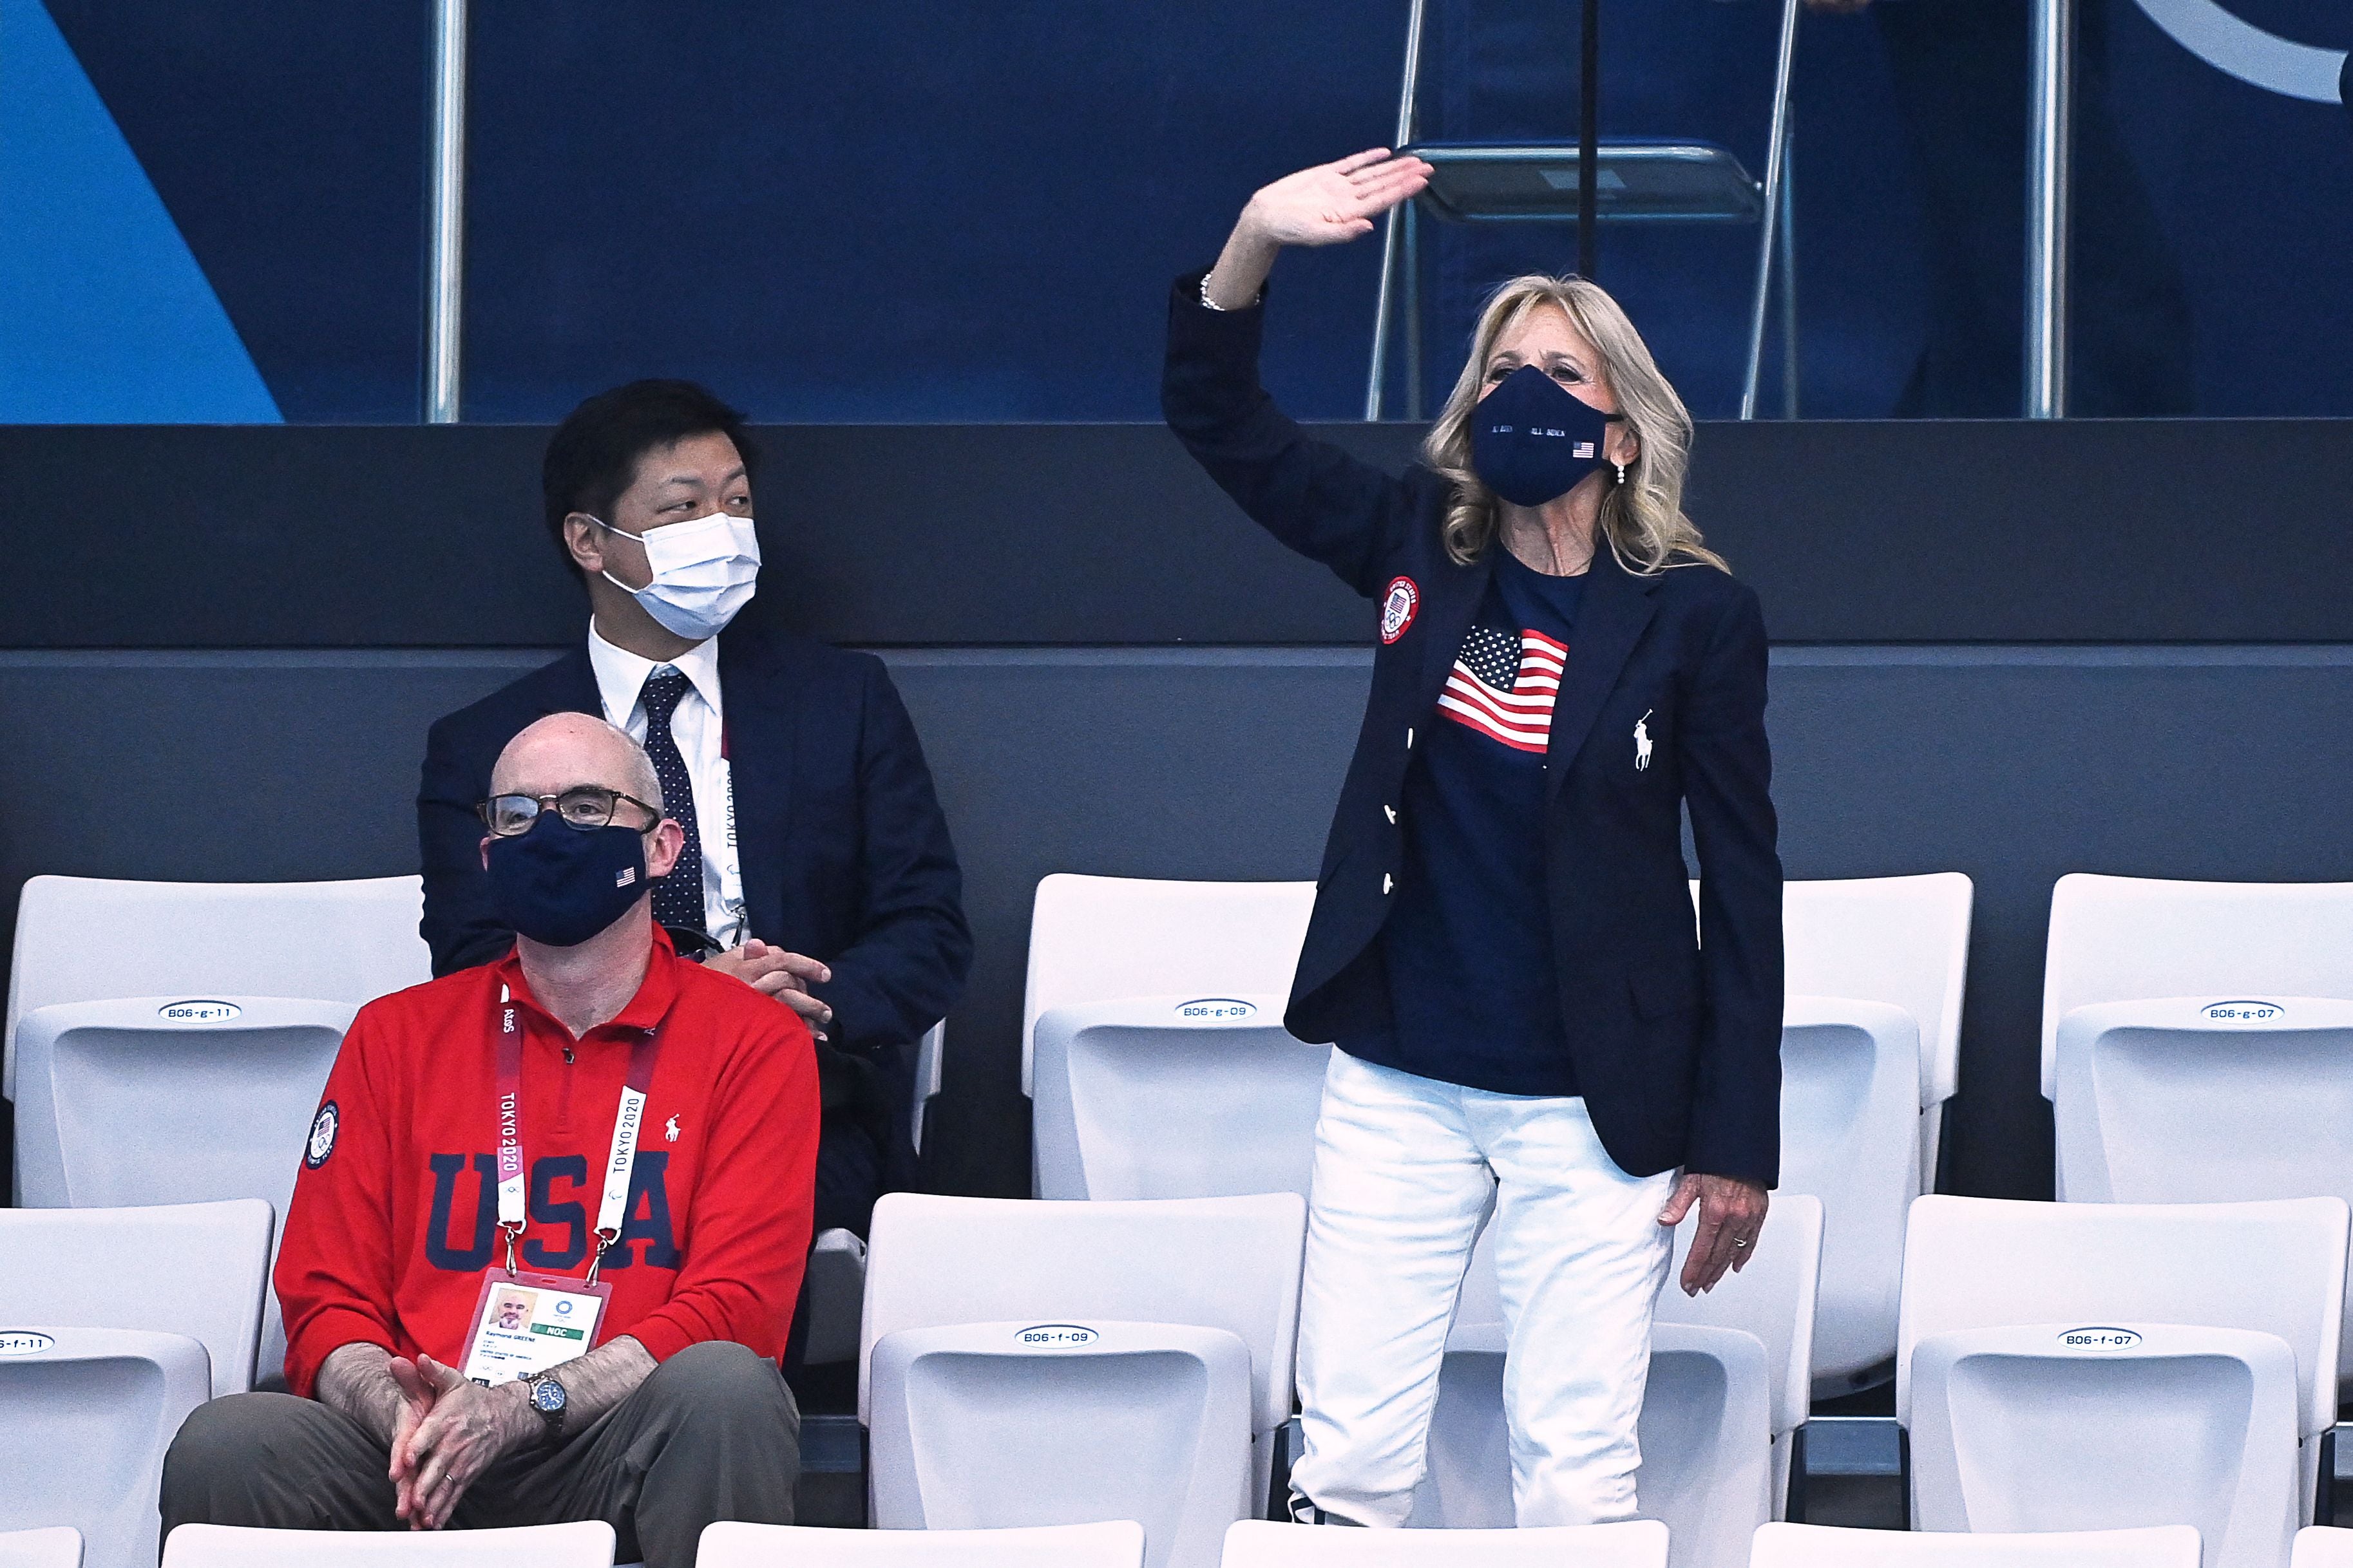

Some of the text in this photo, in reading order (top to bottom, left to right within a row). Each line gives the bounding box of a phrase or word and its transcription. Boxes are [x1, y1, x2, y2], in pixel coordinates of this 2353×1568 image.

[168, 1008, 229, 1018] B06-g-11
[1184, 1007, 1246, 1017] B06-g-09
[2210, 1009, 2274, 1019] B06-g-07
[501, 1092, 518, 1171] TOKYO 2020
[613, 1099, 640, 1174] TOKYO 2020
[425, 1151, 682, 1271] USA
[546, 1327, 567, 1337] NOC
[1024, 1333, 1088, 1342] B06-f-09
[2066, 1336, 2131, 1345] B06-f-07
